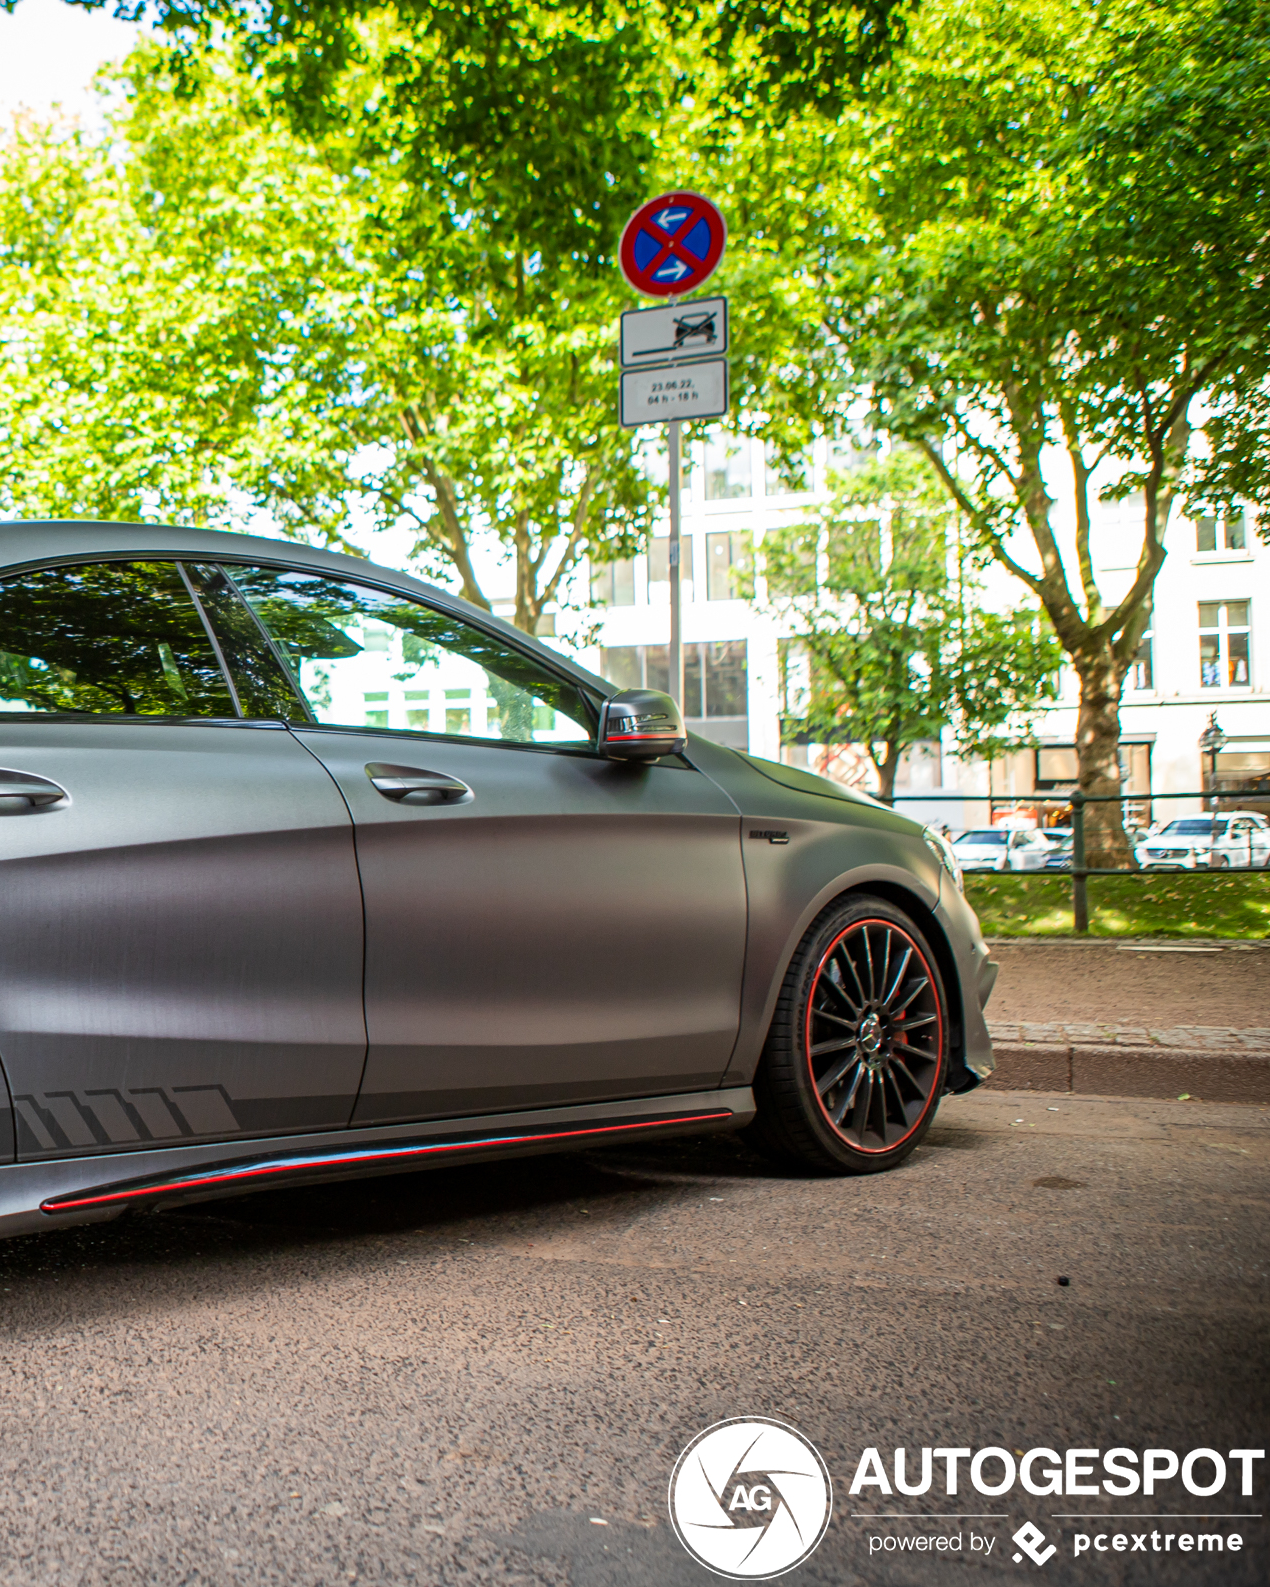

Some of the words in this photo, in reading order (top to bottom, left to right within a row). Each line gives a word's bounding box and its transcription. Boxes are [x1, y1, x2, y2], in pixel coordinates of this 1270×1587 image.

[647, 395, 659, 406] 04
[662, 394, 669, 404] h
[692, 391, 699, 401] h
